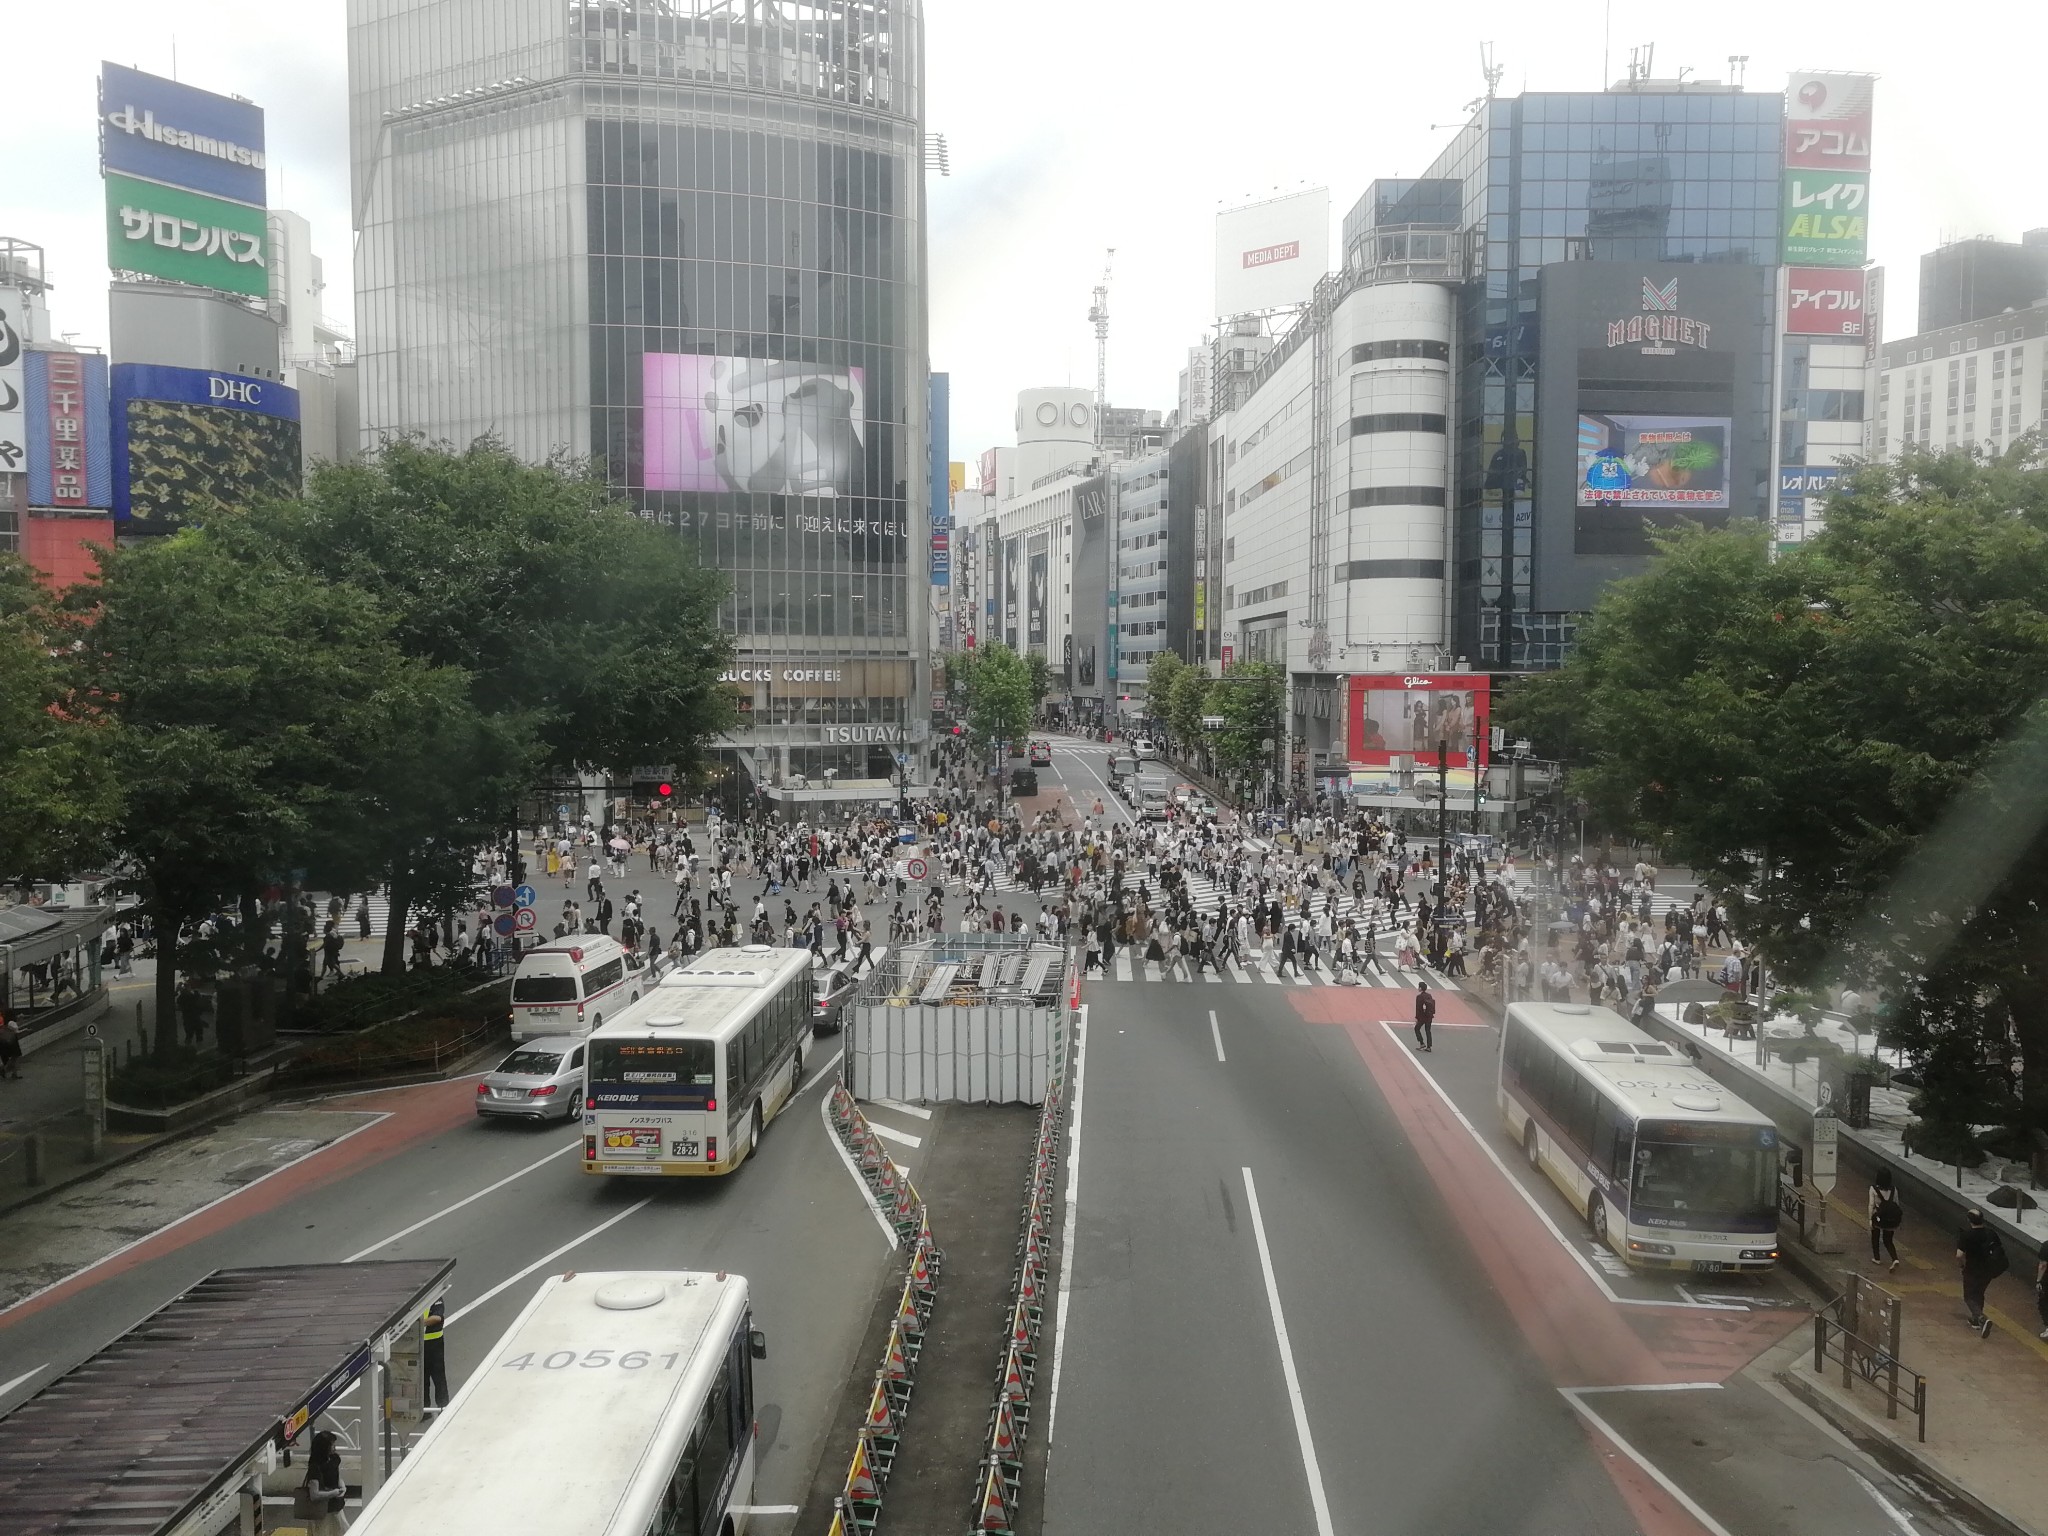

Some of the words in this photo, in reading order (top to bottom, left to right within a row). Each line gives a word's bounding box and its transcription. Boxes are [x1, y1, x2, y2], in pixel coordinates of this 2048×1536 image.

[108, 104, 266, 170] Hisamitsu
[1796, 128, 1870, 156] アコム
[1792, 181, 1866, 210] レイク
[119, 204, 265, 267] サロンパス
[1788, 213, 1866, 240] ALSA
[1247, 250, 1272, 266] MEDIA
[1274, 244, 1297, 260] DEPT.
[1791, 290, 1861, 311] アイフル
[1607, 314, 1710, 349] MAGNET
[1842, 321, 1861, 334] 8F
[208, 376, 262, 405] DHC
[53, 358, 83, 499] 三千里薬品
[1078, 489, 1106, 520] ZARA
[1584, 489, 1724, 500] 法律で禁止されている薬物を使う
[932, 516, 948, 572] SEIBU
[1784, 532, 1795, 540] 6F
[783, 669, 841, 682] COFFEE
[1403, 676, 1433, 689] Glico
[825, 726, 908, 743] TSUTAYA
[597, 1094, 618, 1102] KEIO
[619, 1094, 639, 1102] BUS
[1821, 1085, 1831, 1101] 27
[1648, 1218, 1668, 1226] KEIO
[502, 1349, 680, 1371] 40561
